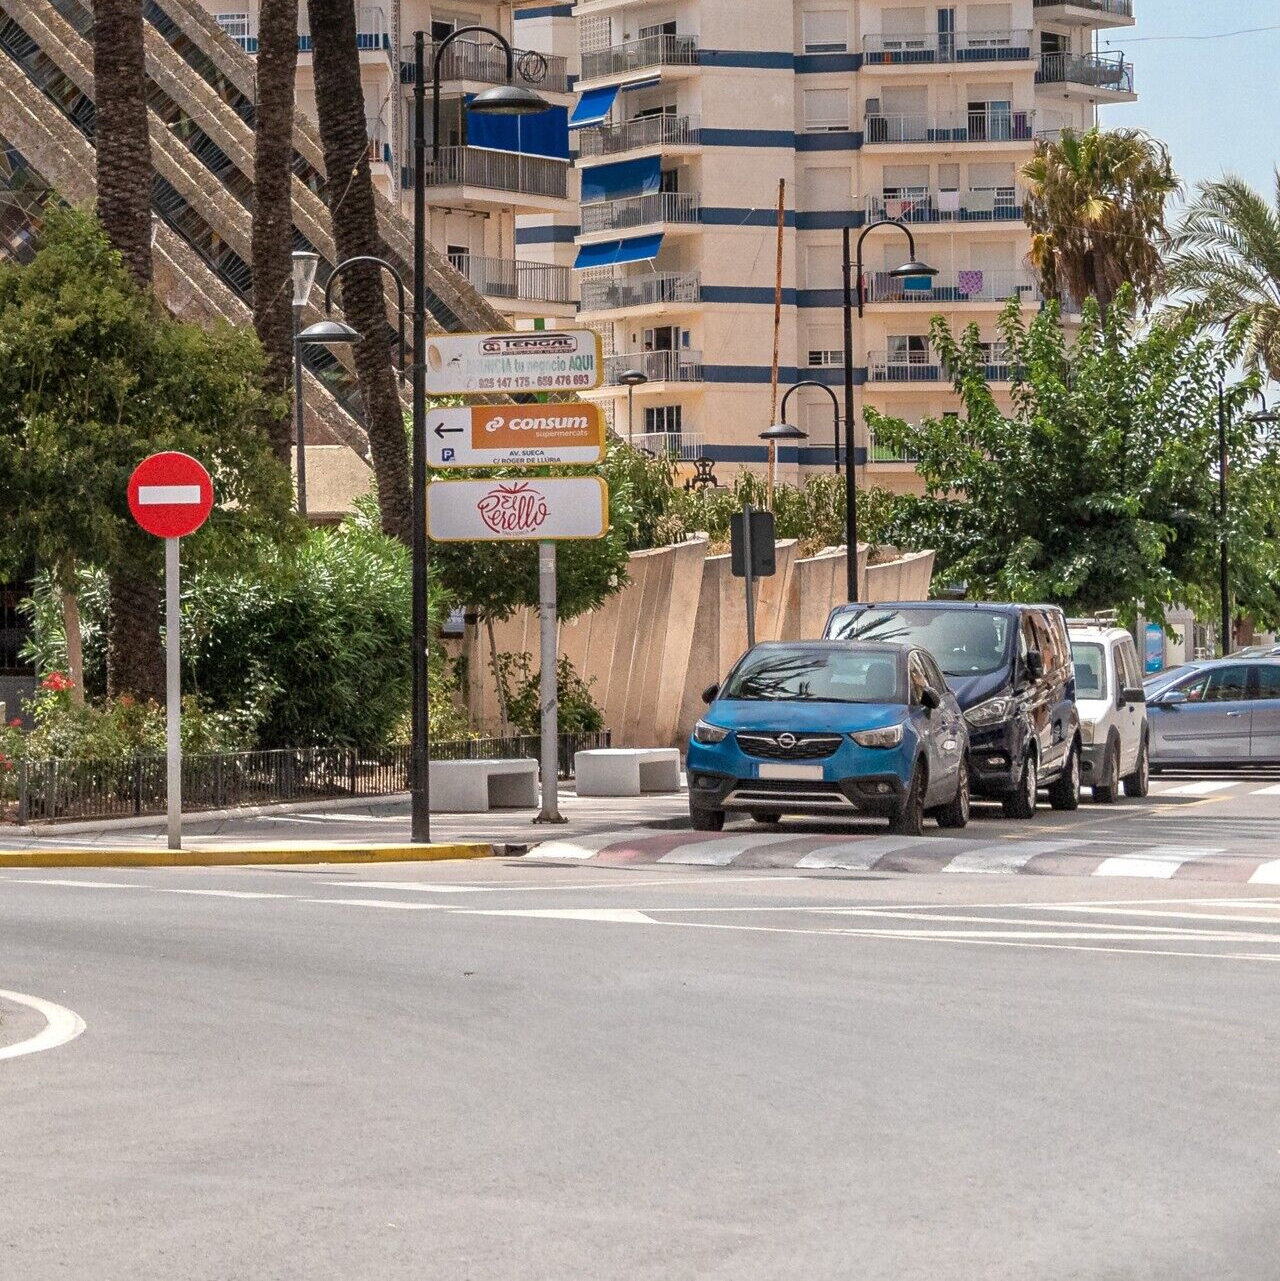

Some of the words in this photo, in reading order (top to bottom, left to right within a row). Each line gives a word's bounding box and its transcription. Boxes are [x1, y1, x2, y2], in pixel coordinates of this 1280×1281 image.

[503, 338, 574, 347] TENGAL
[514, 358, 524, 371] tu
[527, 356, 566, 374] negcio
[568, 354, 594, 371] AQUI
[497, 377, 512, 388] 147
[515, 376, 530, 387] 175
[555, 374, 571, 386] 476
[573, 374, 589, 386] 693
[509, 416, 588, 430] consum
[535, 430, 588, 438] supermercats
